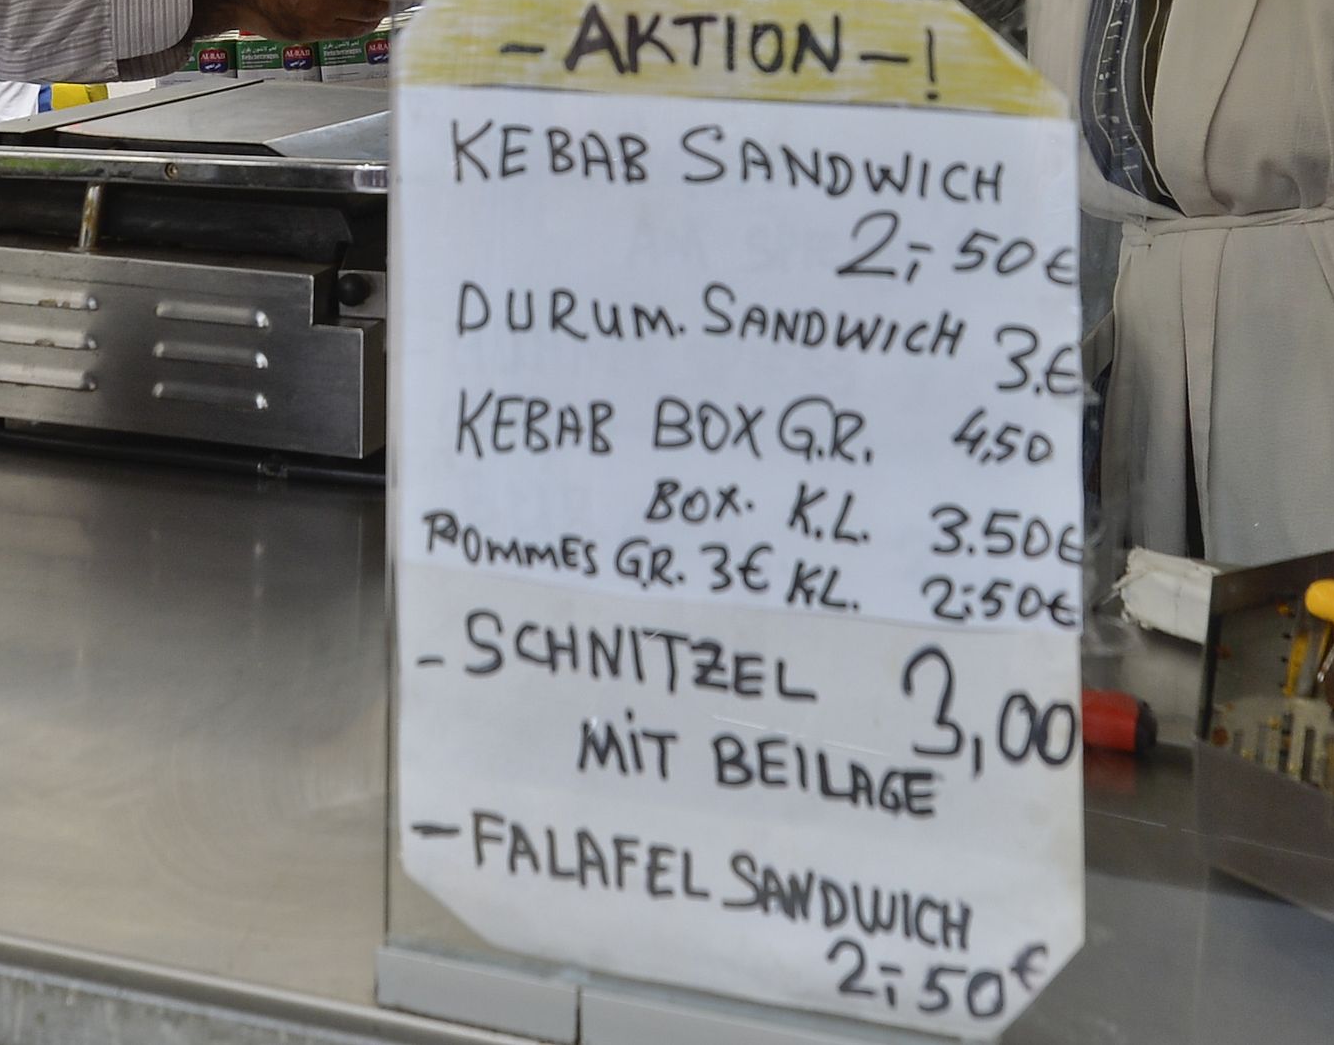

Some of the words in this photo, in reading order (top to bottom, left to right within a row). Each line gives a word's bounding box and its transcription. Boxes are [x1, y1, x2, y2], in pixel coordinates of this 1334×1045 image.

[450, 119, 650, 184] KEBAB
[680, 124, 1004, 202] SANDWICH
[702, 283, 966, 357] SANDWICH
[456, 389, 616, 460] KEBAB
[652, 396, 765, 459] BOX
[901, 645, 1080, 779] 3,00
[712, 733, 938, 818] BEILAGE
[722, 852, 973, 953] SANDWICH
